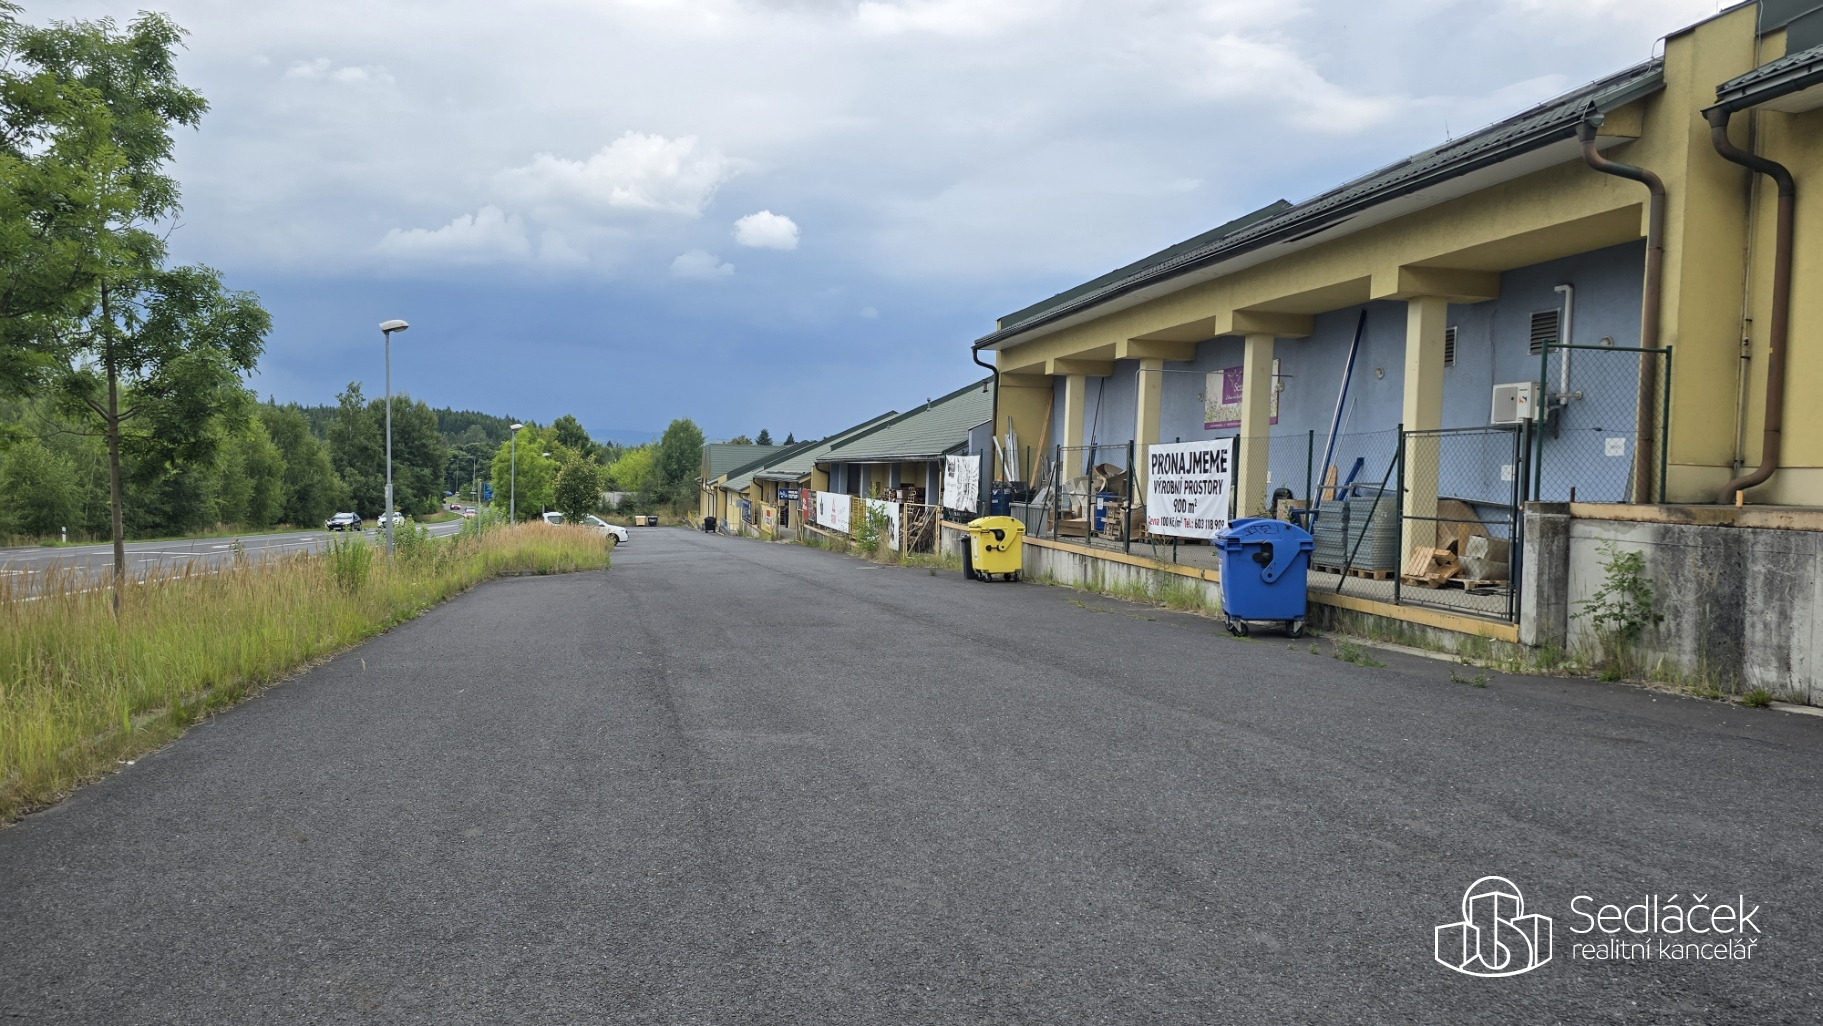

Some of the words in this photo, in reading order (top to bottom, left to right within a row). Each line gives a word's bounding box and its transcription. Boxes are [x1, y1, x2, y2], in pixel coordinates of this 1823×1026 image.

[1151, 449, 1228, 474] PRONAJMEME
[1153, 476, 1183, 495] VÝROBNÍ
[1183, 479, 1224, 495] PROSTORY
[1173, 498, 1187, 514] 900
[1194, 518, 1204, 529] 603
